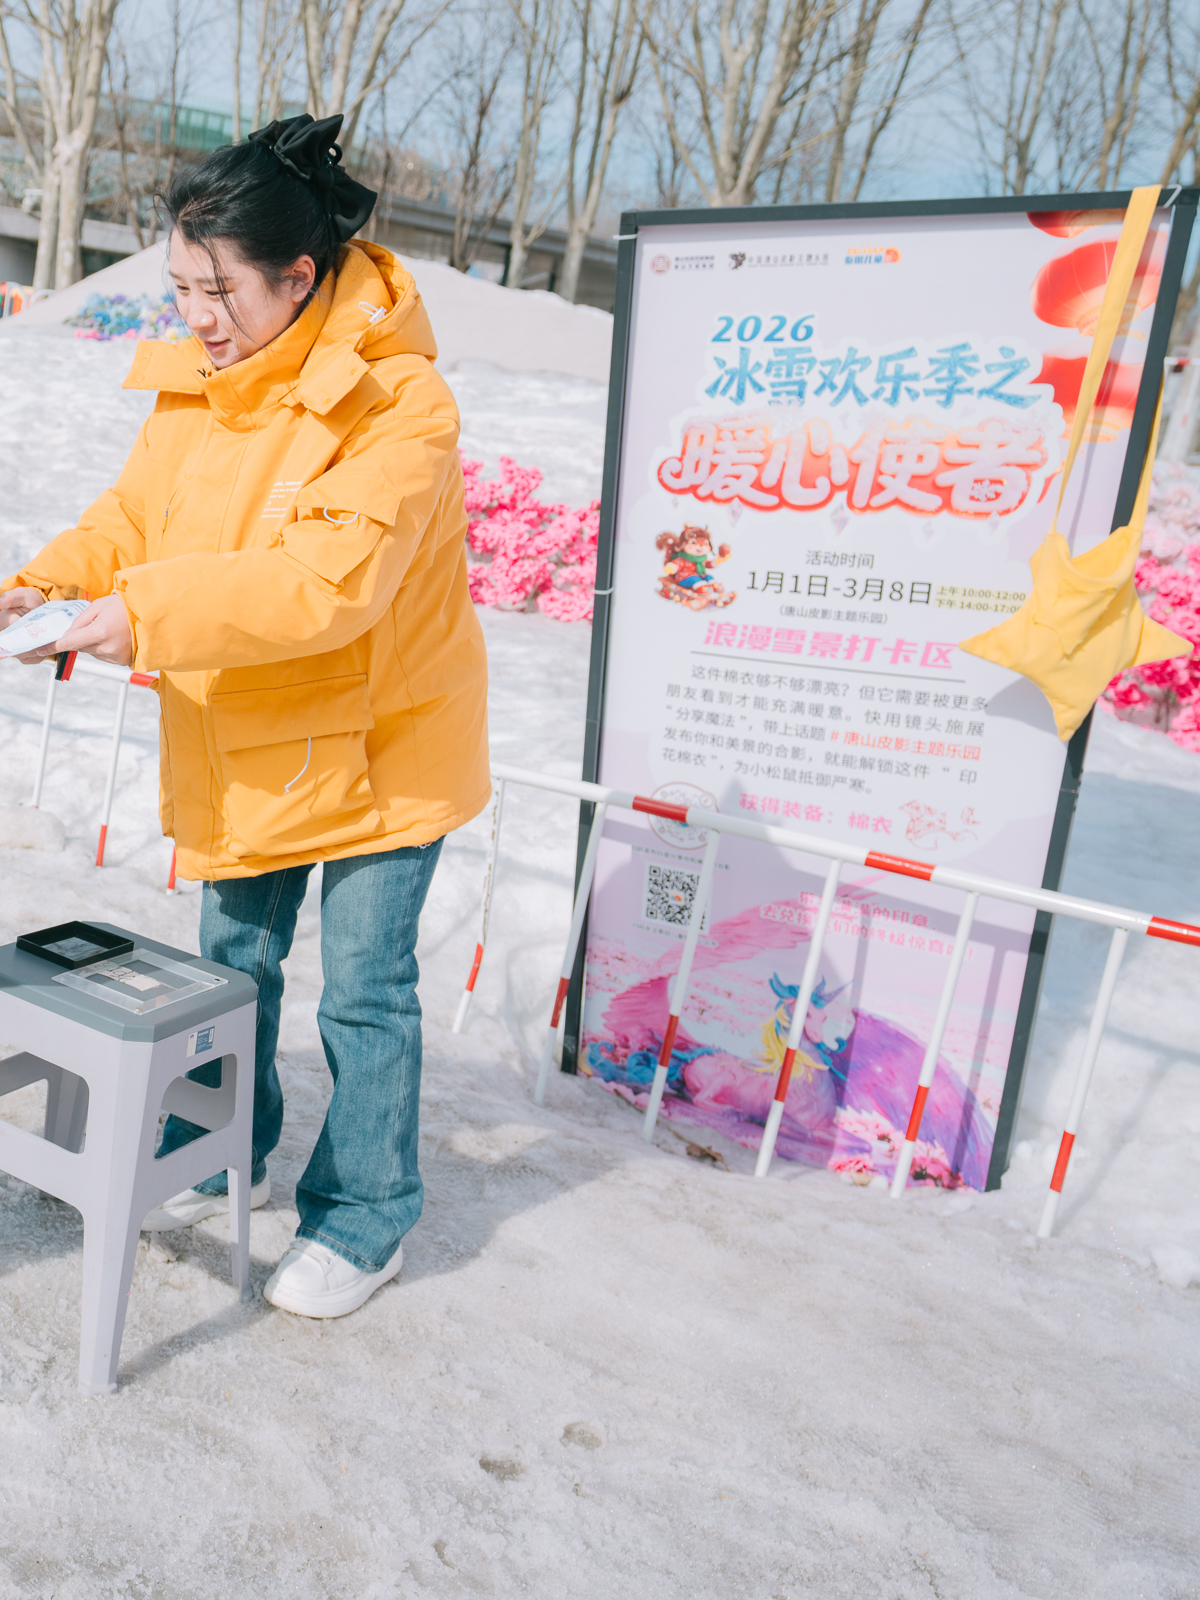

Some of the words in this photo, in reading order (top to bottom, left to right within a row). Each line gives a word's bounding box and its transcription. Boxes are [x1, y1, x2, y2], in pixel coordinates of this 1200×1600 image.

[711, 314, 815, 342] 2026
[705, 342, 1043, 409] 冰雪欢乐季之
[657, 418, 1047, 517] 暖心使者
[806, 550, 875, 569] 活动时间
[746, 571, 932, 604] 1月1日-3月8日
[704, 621, 958, 668] 浪漫雪景打卡区
